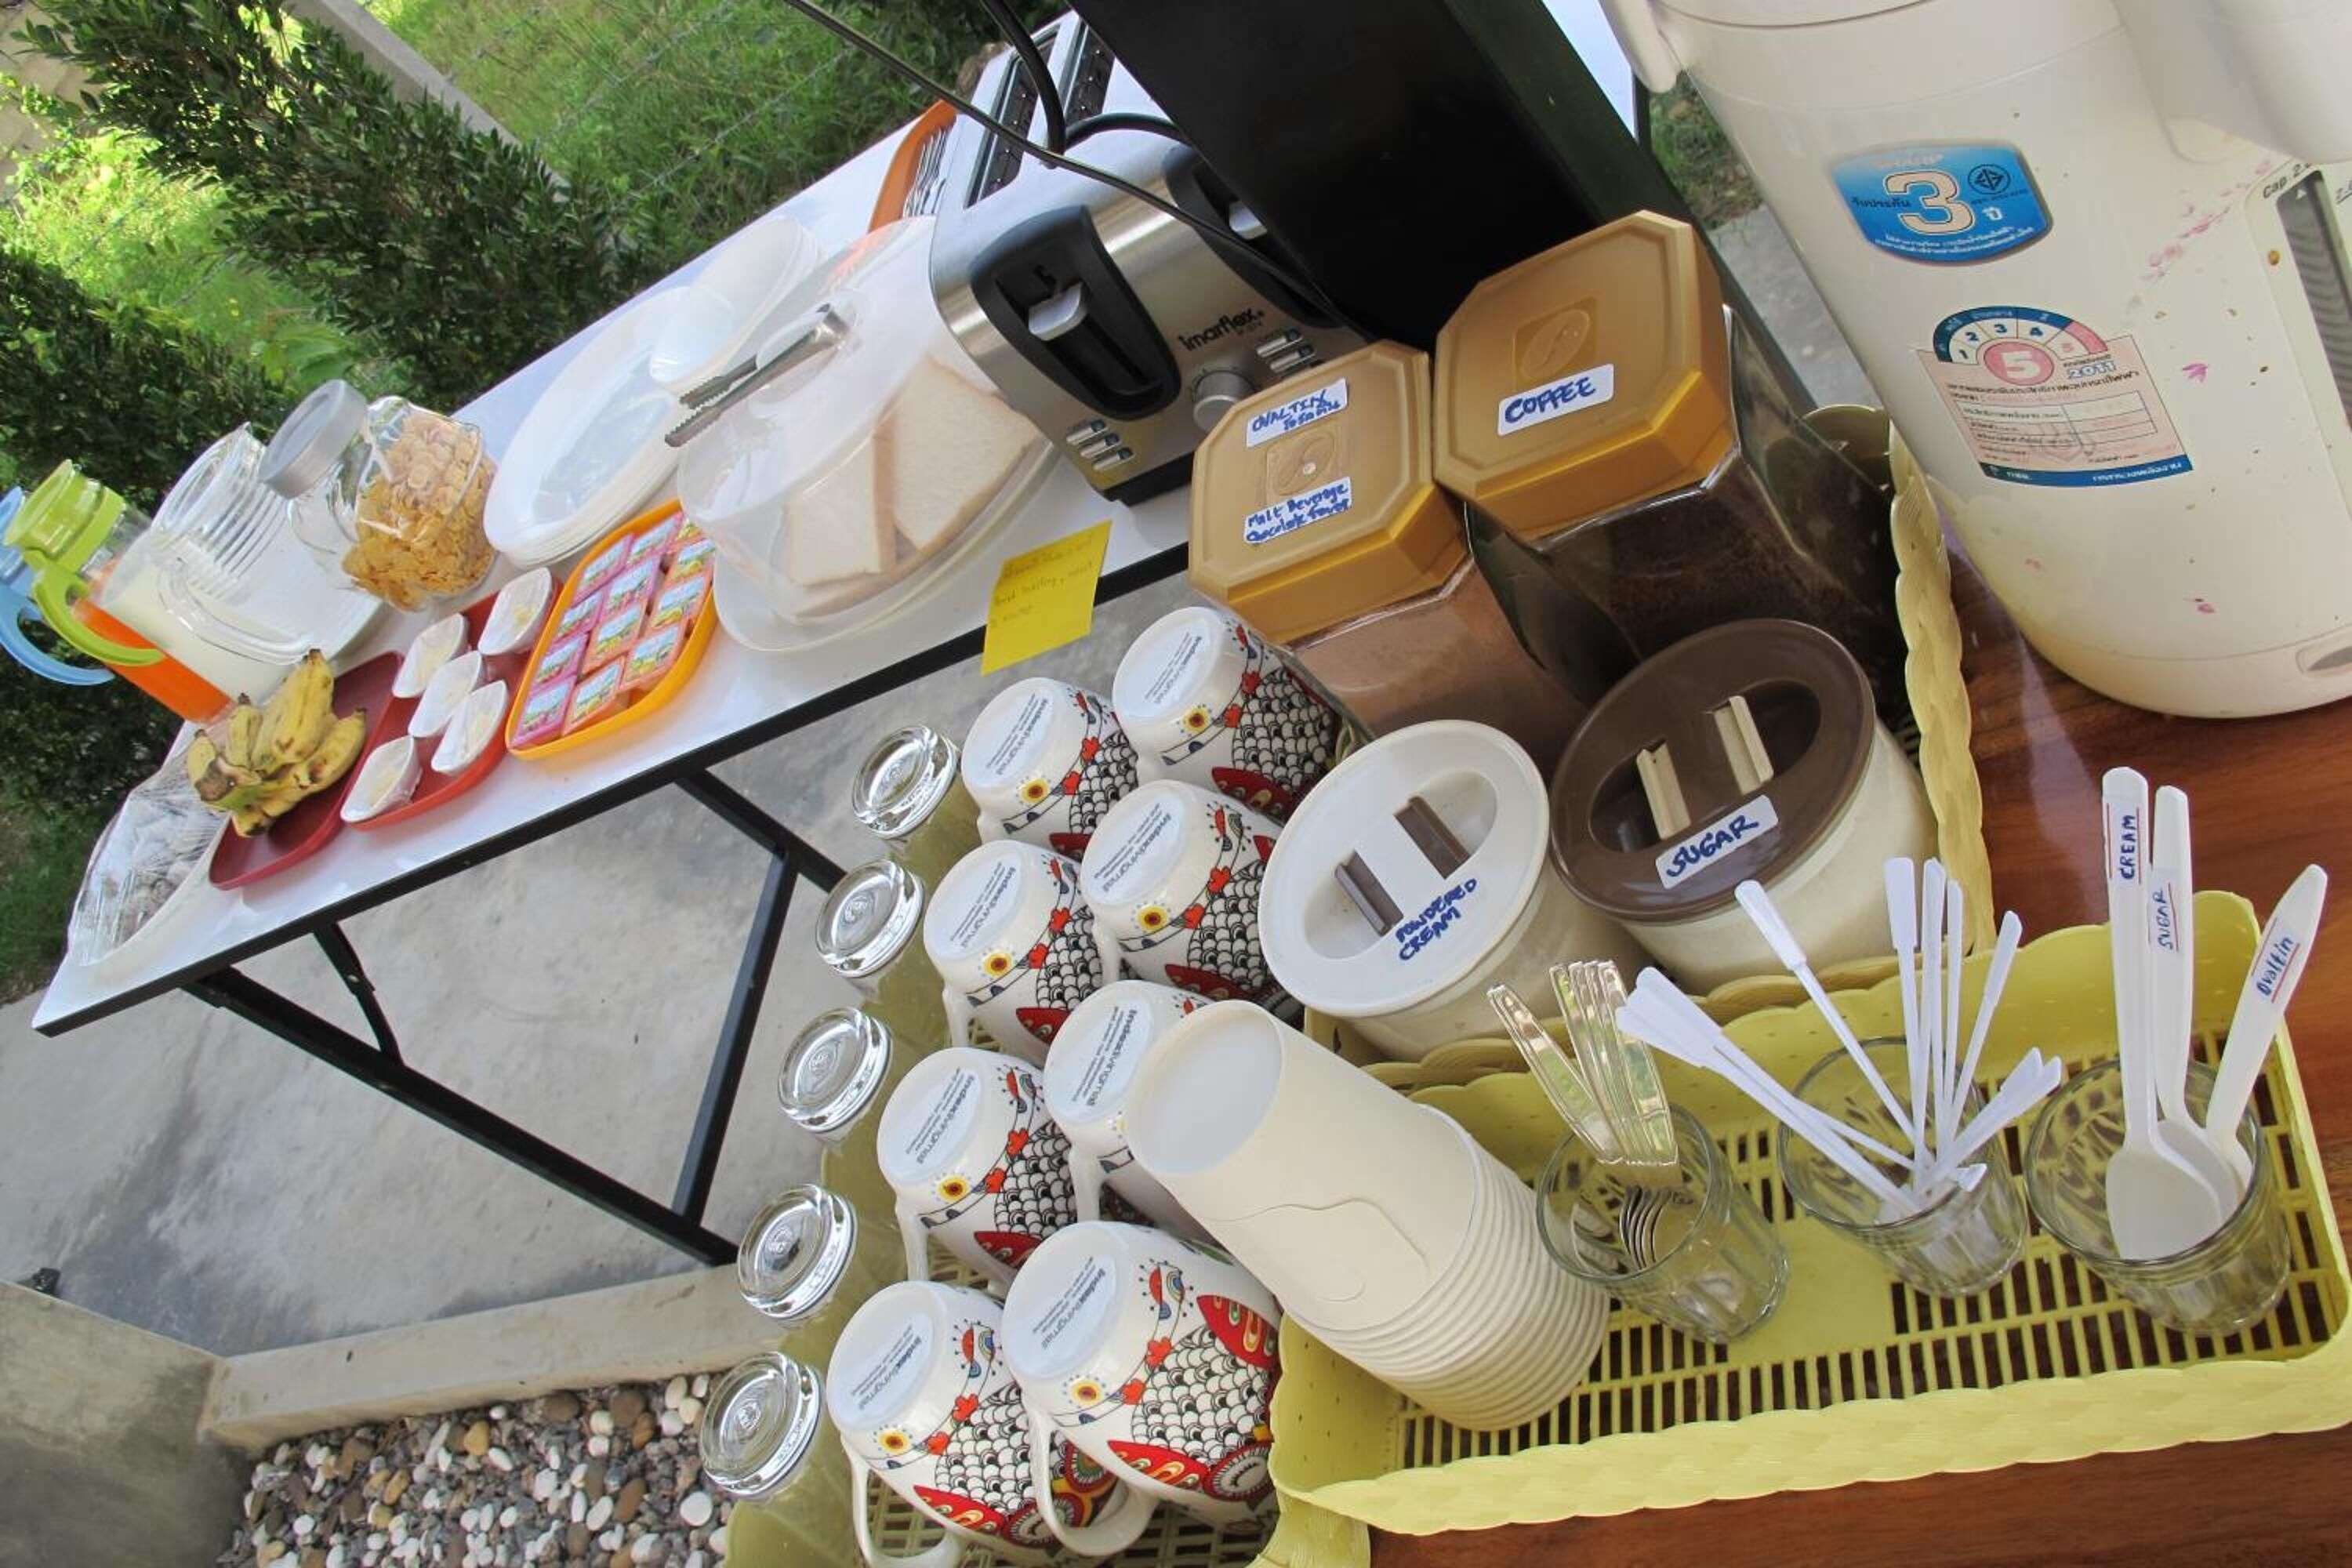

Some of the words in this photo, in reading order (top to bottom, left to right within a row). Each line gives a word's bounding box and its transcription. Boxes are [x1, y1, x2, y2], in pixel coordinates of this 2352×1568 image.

[1883, 169, 1975, 235] 3
[1965, 332, 1979, 342] 2
[1994, 324, 2007, 334] 3
[2000, 350, 2040, 379] 5
[2067, 360, 2118, 380] 2011
[1504, 376, 1597, 423] COFFEE
[1666, 814, 1759, 877] SUGAR
[2119, 815, 2136, 880] CREAM
[1395, 877, 1477, 942] POWDERED
[1399, 906, 1461, 960] CREAM
[2152, 890, 2173, 950] SUGAR
